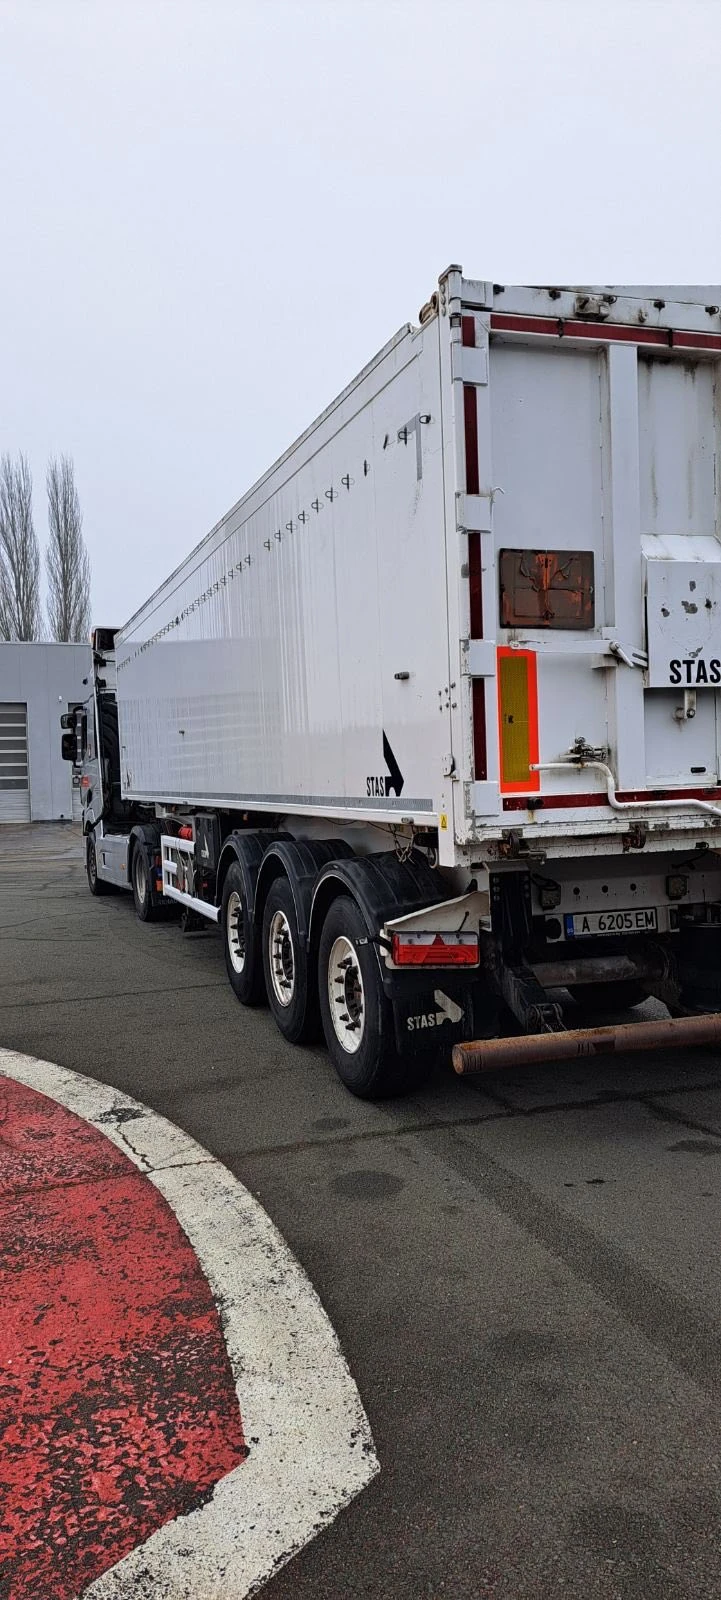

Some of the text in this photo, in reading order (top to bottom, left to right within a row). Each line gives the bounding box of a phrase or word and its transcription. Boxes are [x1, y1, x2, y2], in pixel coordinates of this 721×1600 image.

[669, 659, 721, 684] STAS
[366, 776, 384, 797] STAS
[582, 916, 590, 932] A
[598, 913, 633, 931] 6205
[635, 911, 655, 928] EM
[407, 1013, 435, 1031] STAS
